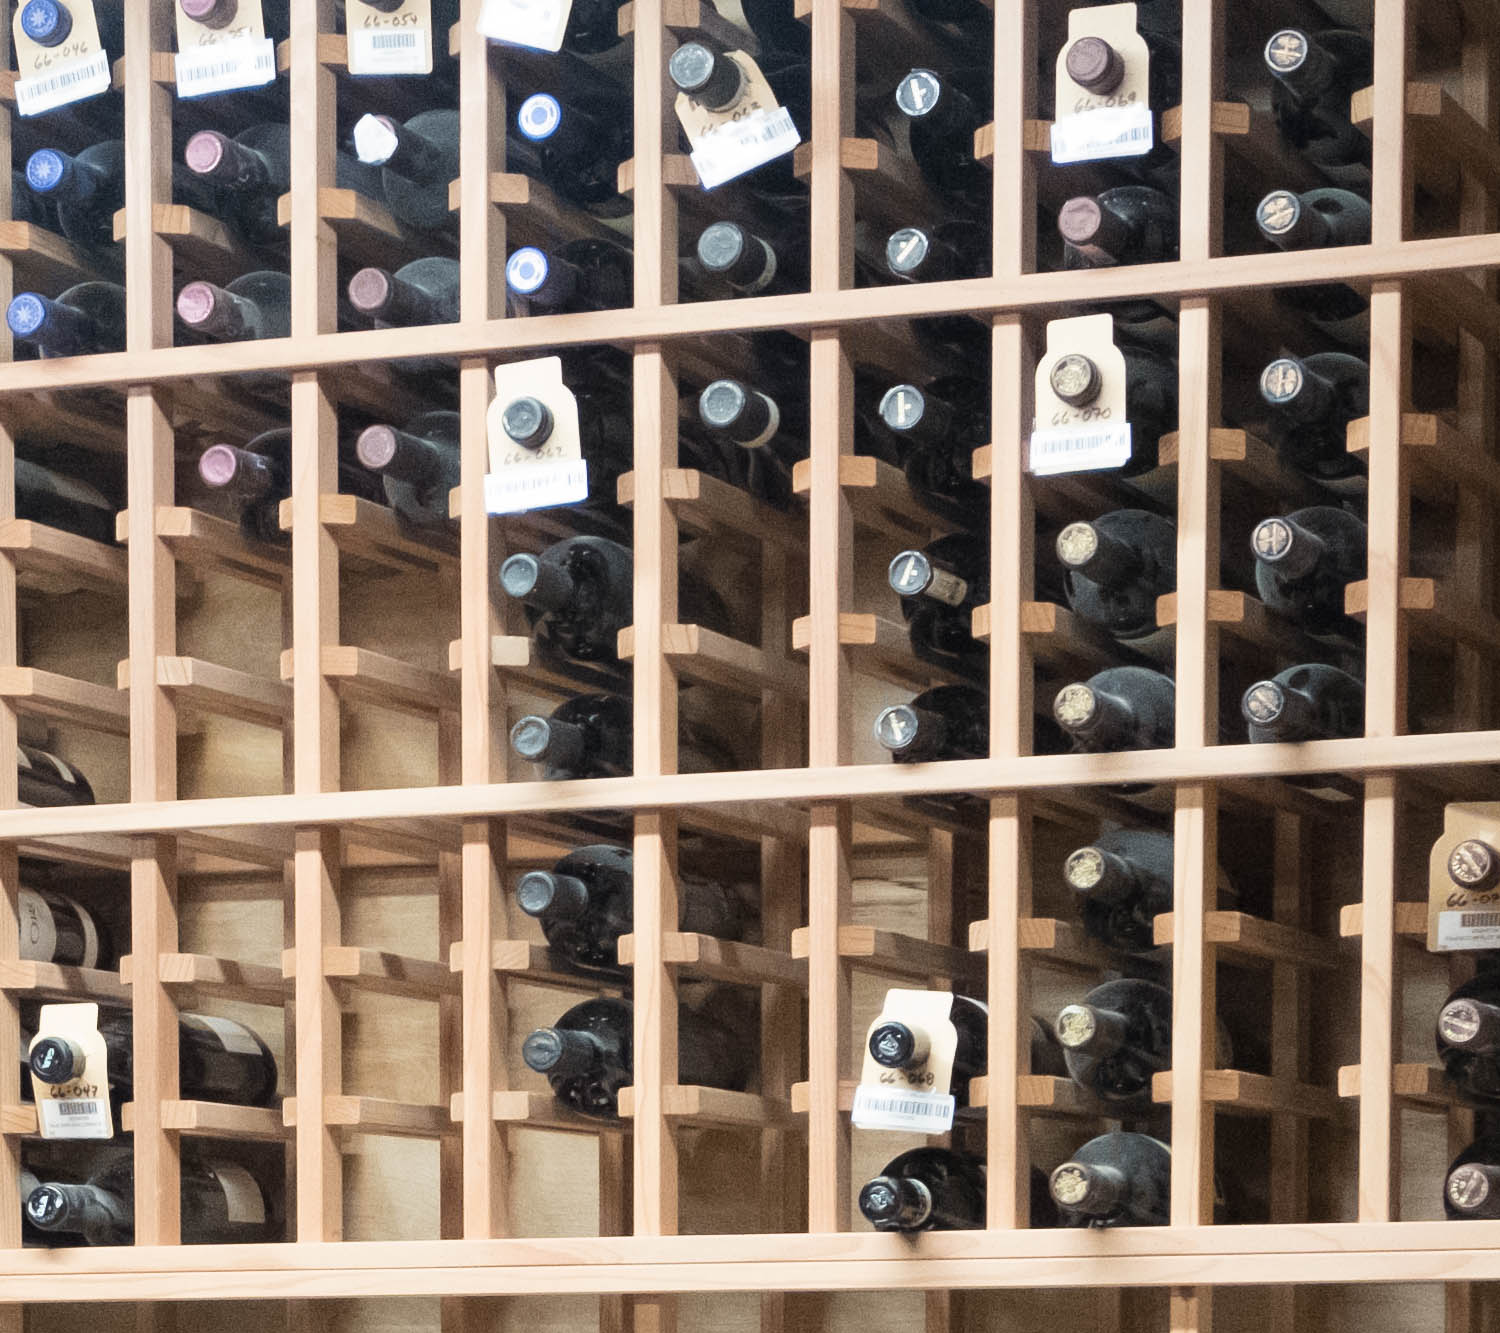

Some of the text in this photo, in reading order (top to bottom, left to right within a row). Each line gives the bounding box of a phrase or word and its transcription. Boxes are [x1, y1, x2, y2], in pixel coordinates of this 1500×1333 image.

[34, 45, 89, 71] 66-046
[1052, 408, 1113, 426] 66-070
[50, 1085, 98, 1099] 66-047
